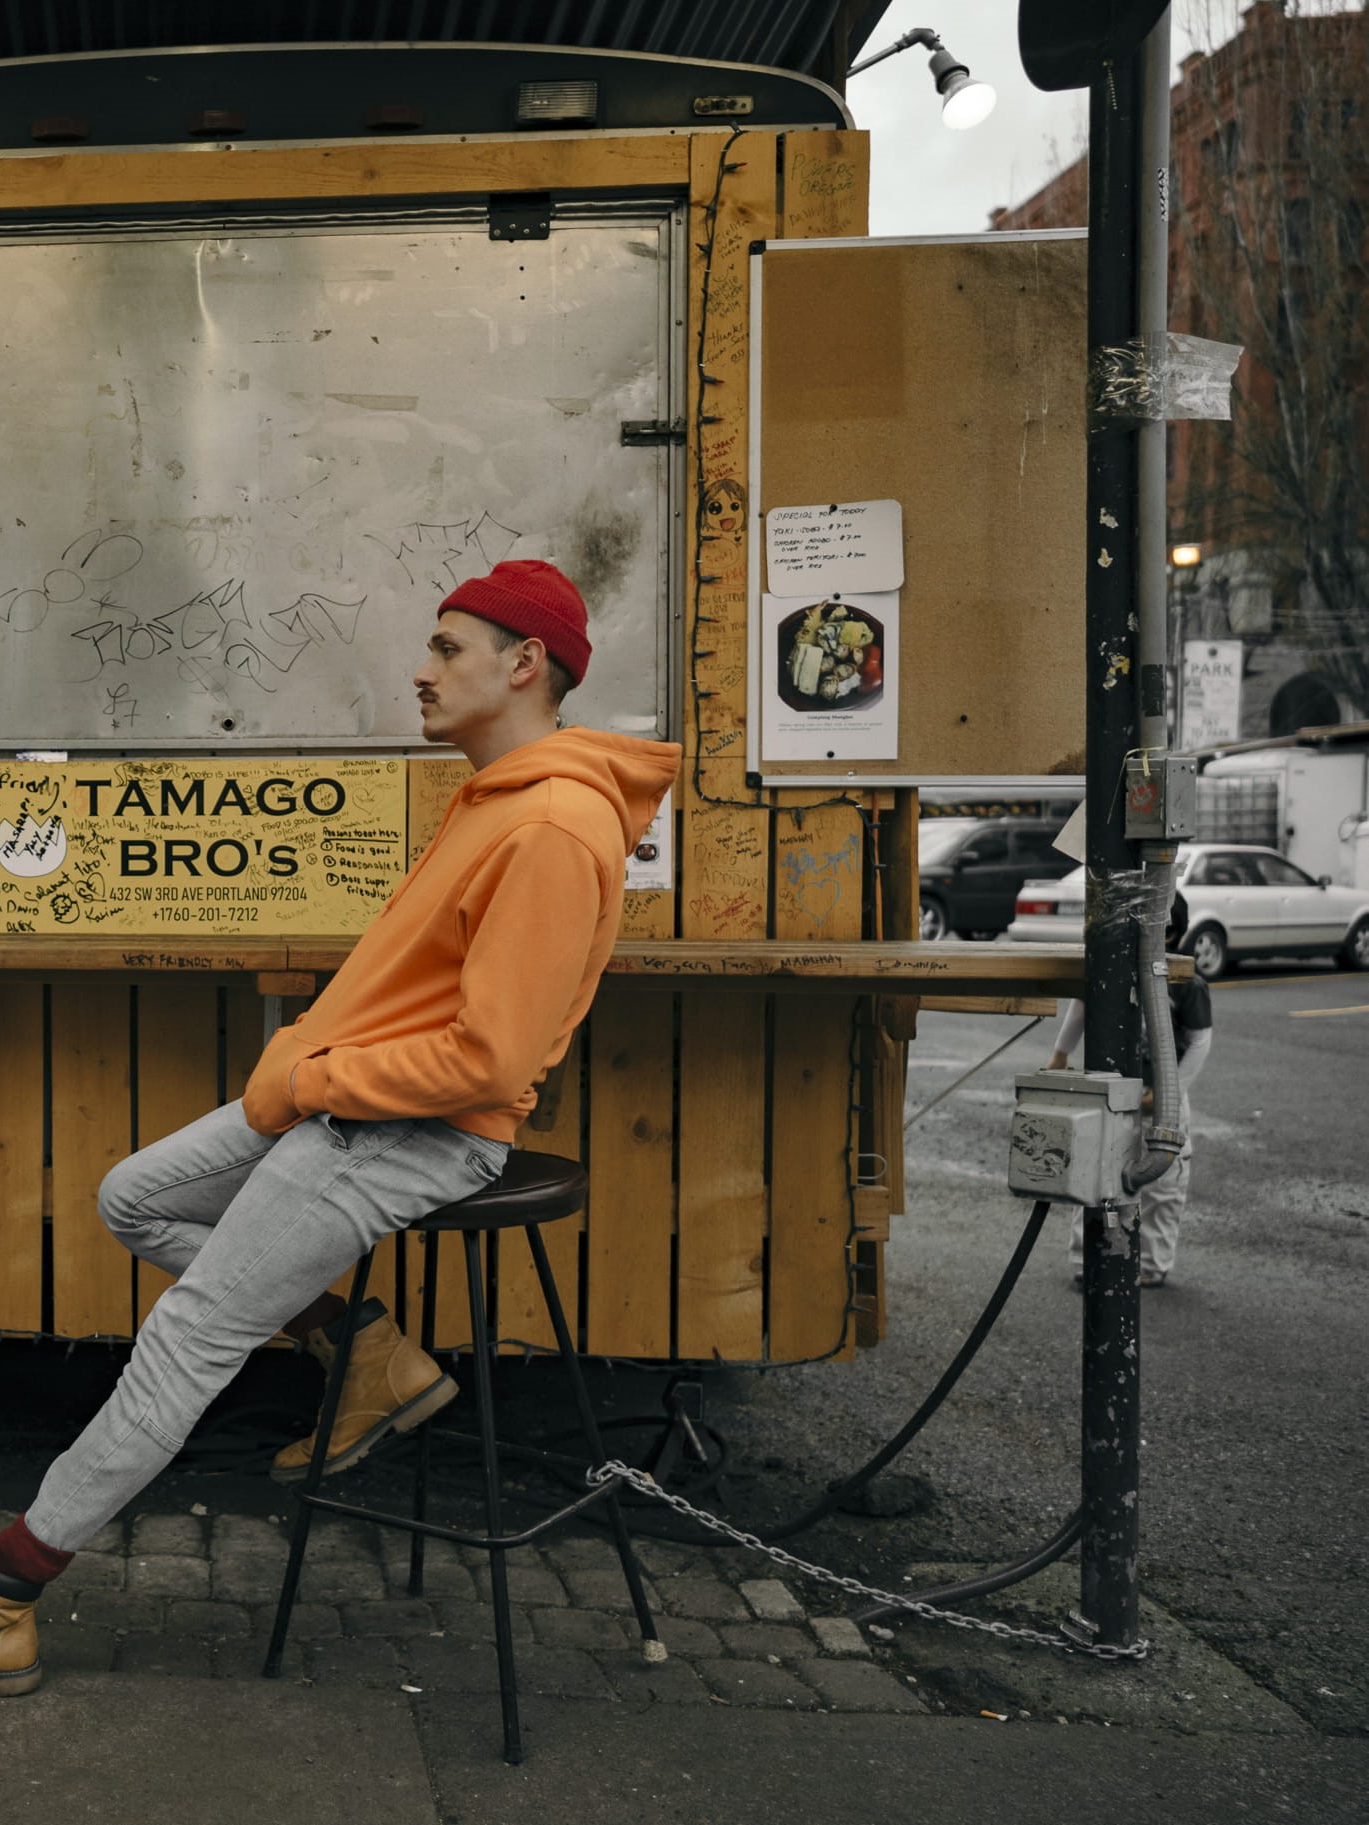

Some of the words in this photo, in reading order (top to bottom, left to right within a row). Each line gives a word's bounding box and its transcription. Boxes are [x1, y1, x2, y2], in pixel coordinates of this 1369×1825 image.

[1191, 663, 1232, 676] PARK
[76, 778, 345, 817] TAMAGO
[336, 844, 356, 854] Food
[120, 838, 299, 877] BRO's
[110, 887, 131, 901] 432
[134, 887, 152, 901] SW
[155, 887, 179, 901] 3RD
[181, 887, 204, 901] AVE
[206, 887, 268, 901] PORTLAND
[271, 887, 307, 901] 97204
[152, 907, 259, 922] +1760-201-7212
[121, 952, 154, 968] VERY
[159, 954, 213, 969] FRIENDLY
